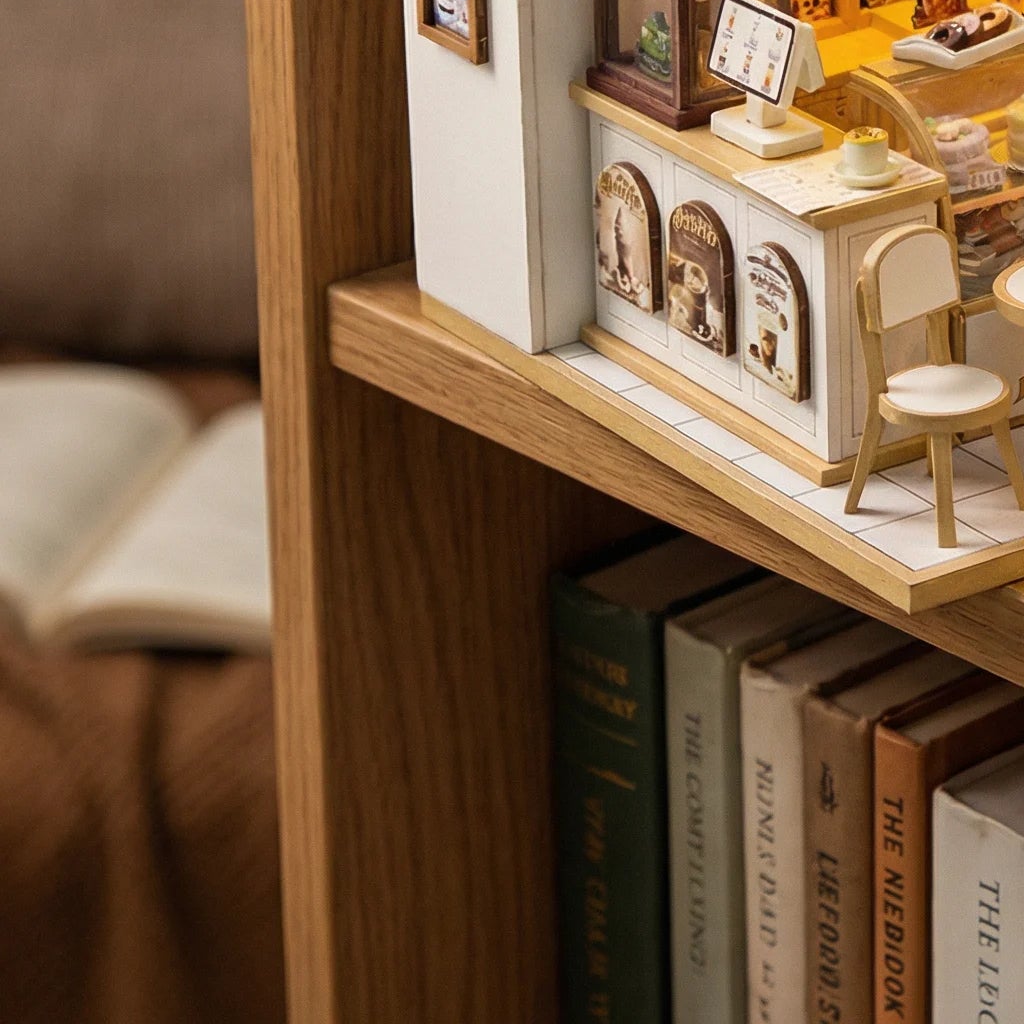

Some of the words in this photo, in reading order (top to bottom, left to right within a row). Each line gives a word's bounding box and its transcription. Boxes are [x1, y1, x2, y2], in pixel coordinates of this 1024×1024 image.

[685, 712, 703, 765] THE
[883, 796, 905, 857] THE
[978, 879, 1001, 953] THE
